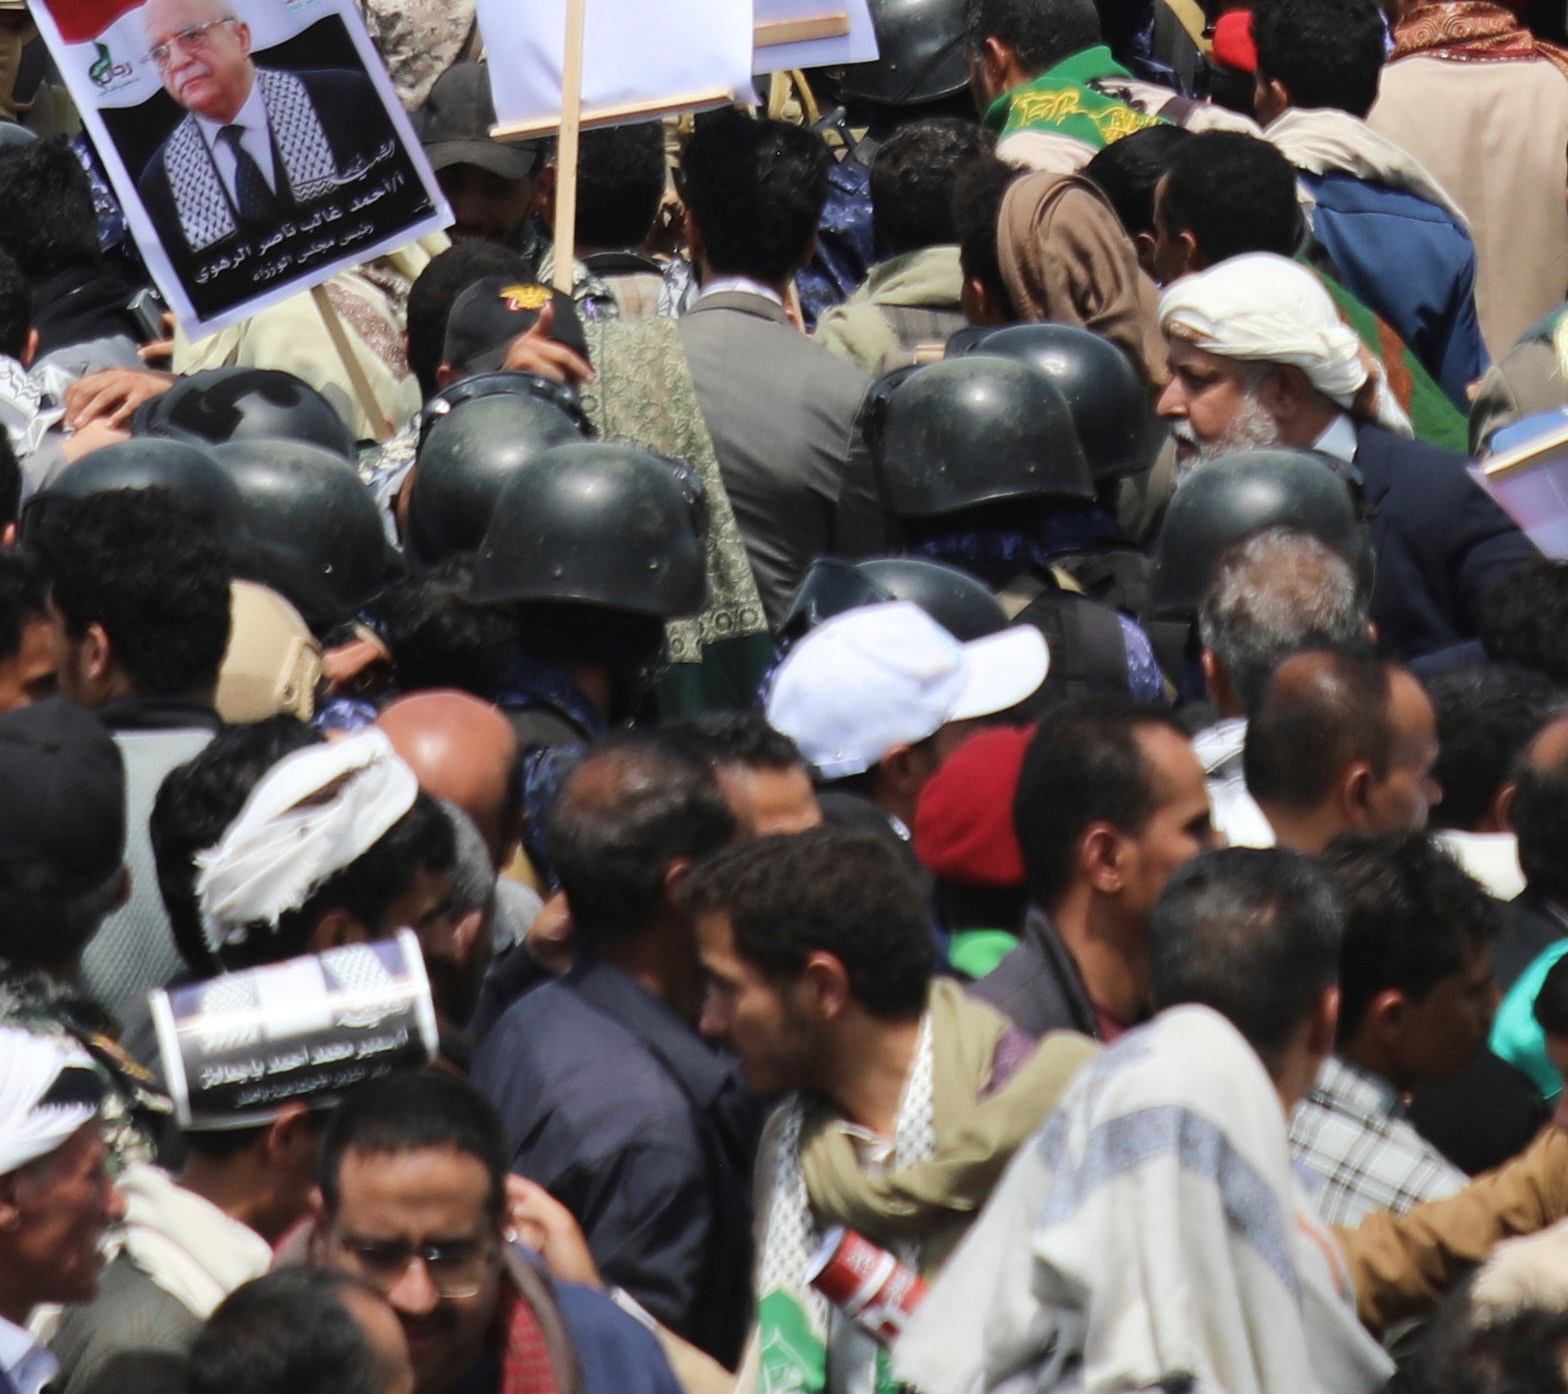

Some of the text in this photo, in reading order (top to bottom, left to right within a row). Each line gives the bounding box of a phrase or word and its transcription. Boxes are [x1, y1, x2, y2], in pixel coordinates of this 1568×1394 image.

[300, 206, 343, 233] غالب
[252, 224, 375, 282] رئيس مجلس الوزراء
[258, 224, 298, 257] ناصر
[195, 244, 252, 284] الرهوي
